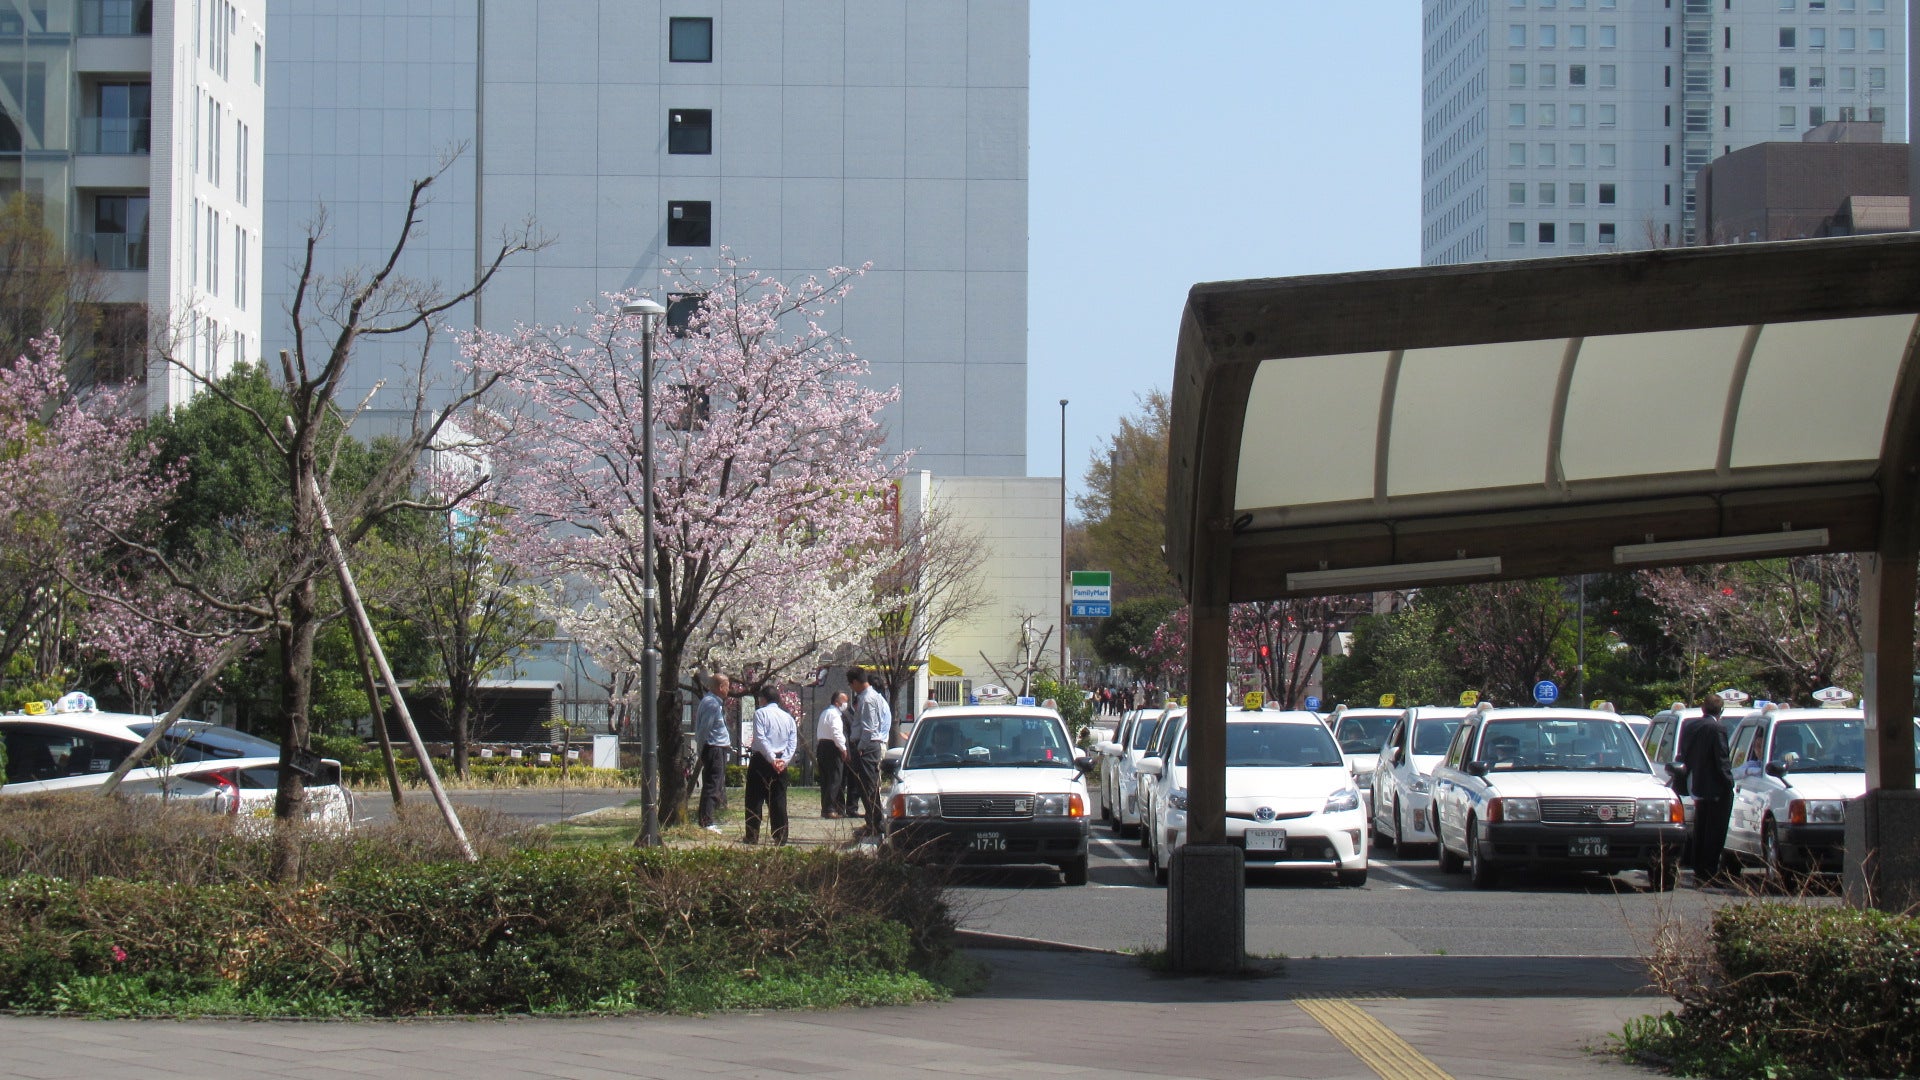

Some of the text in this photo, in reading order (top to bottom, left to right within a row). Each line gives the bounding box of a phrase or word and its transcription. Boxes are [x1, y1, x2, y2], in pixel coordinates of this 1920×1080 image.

[1074, 589, 1109, 597] FamilyMart
[1076, 605, 1107, 615] 酒 たばこ
[977, 839, 1006, 850] 17-16
